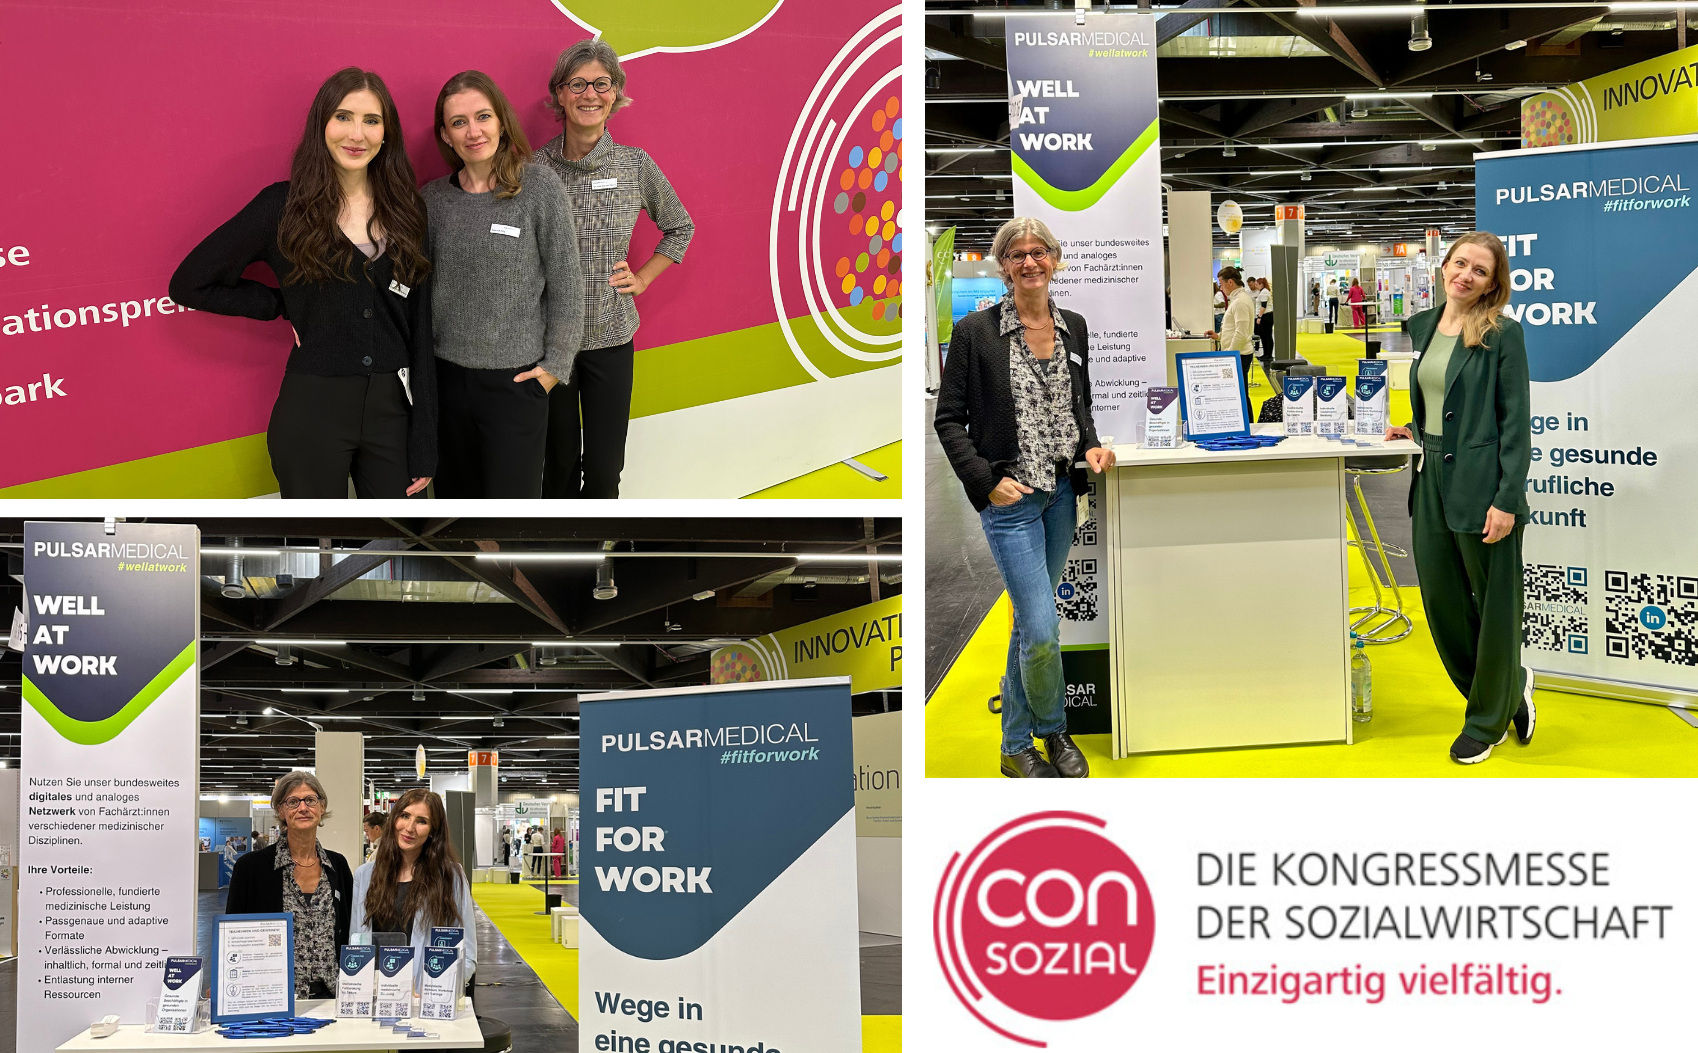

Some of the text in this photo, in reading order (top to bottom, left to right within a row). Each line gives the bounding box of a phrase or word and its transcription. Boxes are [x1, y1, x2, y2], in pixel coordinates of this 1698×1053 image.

[1015, 32, 1150, 46] PULSARMEDICAL
[1088, 49, 1148, 58] #wellatwork
[1017, 80, 1080, 97] WELL
[1020, 107, 1049, 124] AT
[1019, 133, 1093, 150] WORK
[1496, 174, 1690, 205] PULSARMEDICAL
[1603, 195, 1691, 212] #fitforwork
[1288, 208, 1294, 218] 7
[1095, 239, 1150, 247] bundesweites
[1395, 244, 1405, 255] 7A
[1081, 252, 1117, 261] analoges
[1084, 264, 1143, 272] Fachärzt:innen
[1084, 276, 1139, 284] medizinischer
[2, 296, 197, 336] ationspre
[1097, 343, 1131, 351] Leistung
[1112, 354, 1147, 363] adaptive
[1095, 379, 1140, 387] Abwicklung
[0, 373, 67, 406] ark
[1567, 412, 1588, 431] in
[1550, 446, 1658, 467] gesunde
[34, 542, 189, 559] PULSARMEDICAL
[118, 562, 187, 572] #wellatwork
[34, 595, 105, 615] WELL
[33, 625, 69, 645] AT
[33, 655, 118, 676] WORK
[1065, 683, 1096, 695] SAR
[601, 722, 818, 753] PULSARMEDICAL
[482, 754, 487, 763] 7
[720, 747, 820, 764] #fitforwork
[29, 777, 180, 787] Nutzen Sie unser bundesweites
[29, 792, 140, 803] digitales und analoges
[596, 786, 646, 813] FIT
[29, 806, 76, 816] Netzwerk
[99, 807, 170, 816] Fachärzt:innen
[28, 822, 165, 831] verschiedener medizinischer
[28, 836, 83, 846] Disziplinen.
[596, 826, 665, 851] FOR
[28, 866, 93, 874] Ihre Vorteile:
[595, 866, 713, 893] WORK
[45, 887, 161, 897] Professionelle, fundierte
[45, 902, 151, 912] medizinische Leistung
[45, 916, 169, 926] Passgenaue und adaptive
[45, 931, 85, 940] Formate
[45, 946, 103, 955] Verlässliche
[105, 946, 159, 956] Abwicklung
[44, 960, 89, 971] inhaltlich,
[91, 960, 122, 969] formal
[124, 960, 141, 969] und
[44, 975, 134, 986] Entlastung interner
[44, 990, 101, 999] Ressourcen
[594, 991, 703, 1023] Wege in
[594, 1029, 651, 1053] eine
